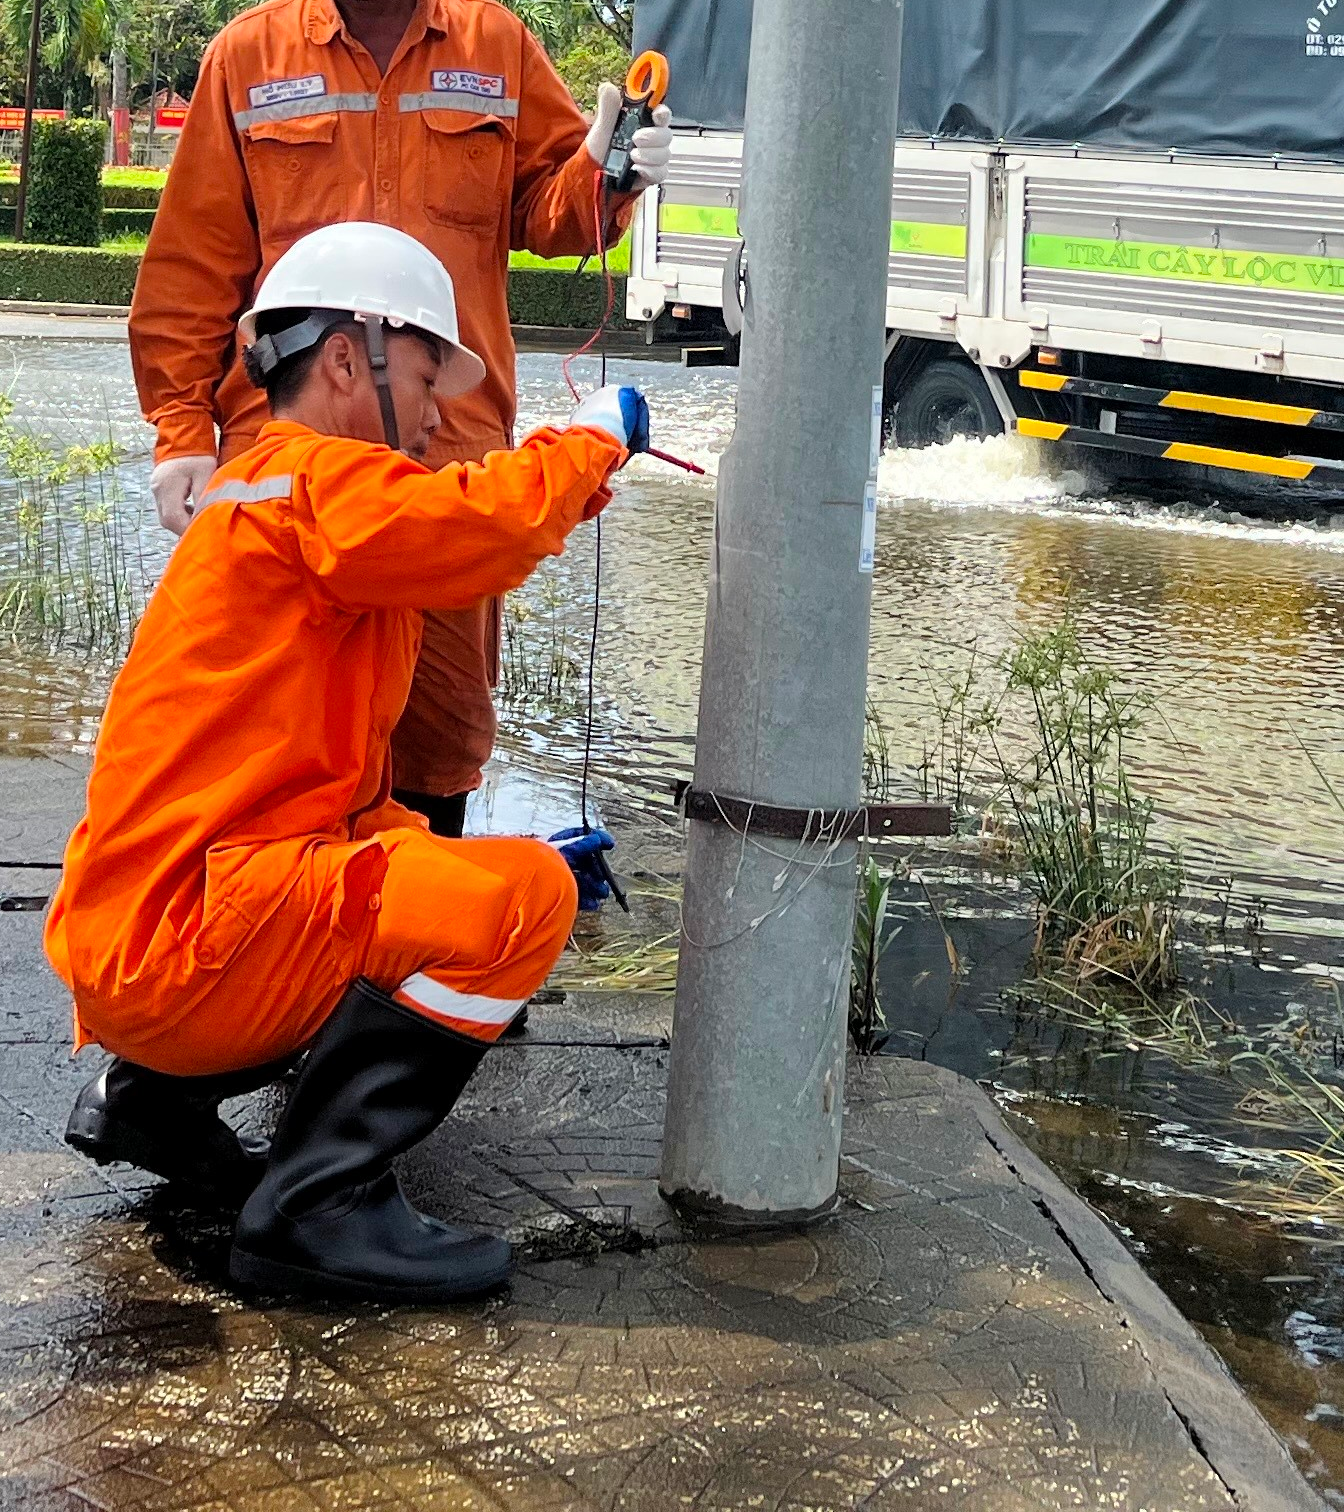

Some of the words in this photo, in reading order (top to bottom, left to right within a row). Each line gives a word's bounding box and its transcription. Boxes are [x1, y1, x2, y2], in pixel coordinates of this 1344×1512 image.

[1065, 241, 1140, 270] TRÁI
[1148, 246, 1217, 276] CÂY
[1222, 256, 1296, 286] LỘC
